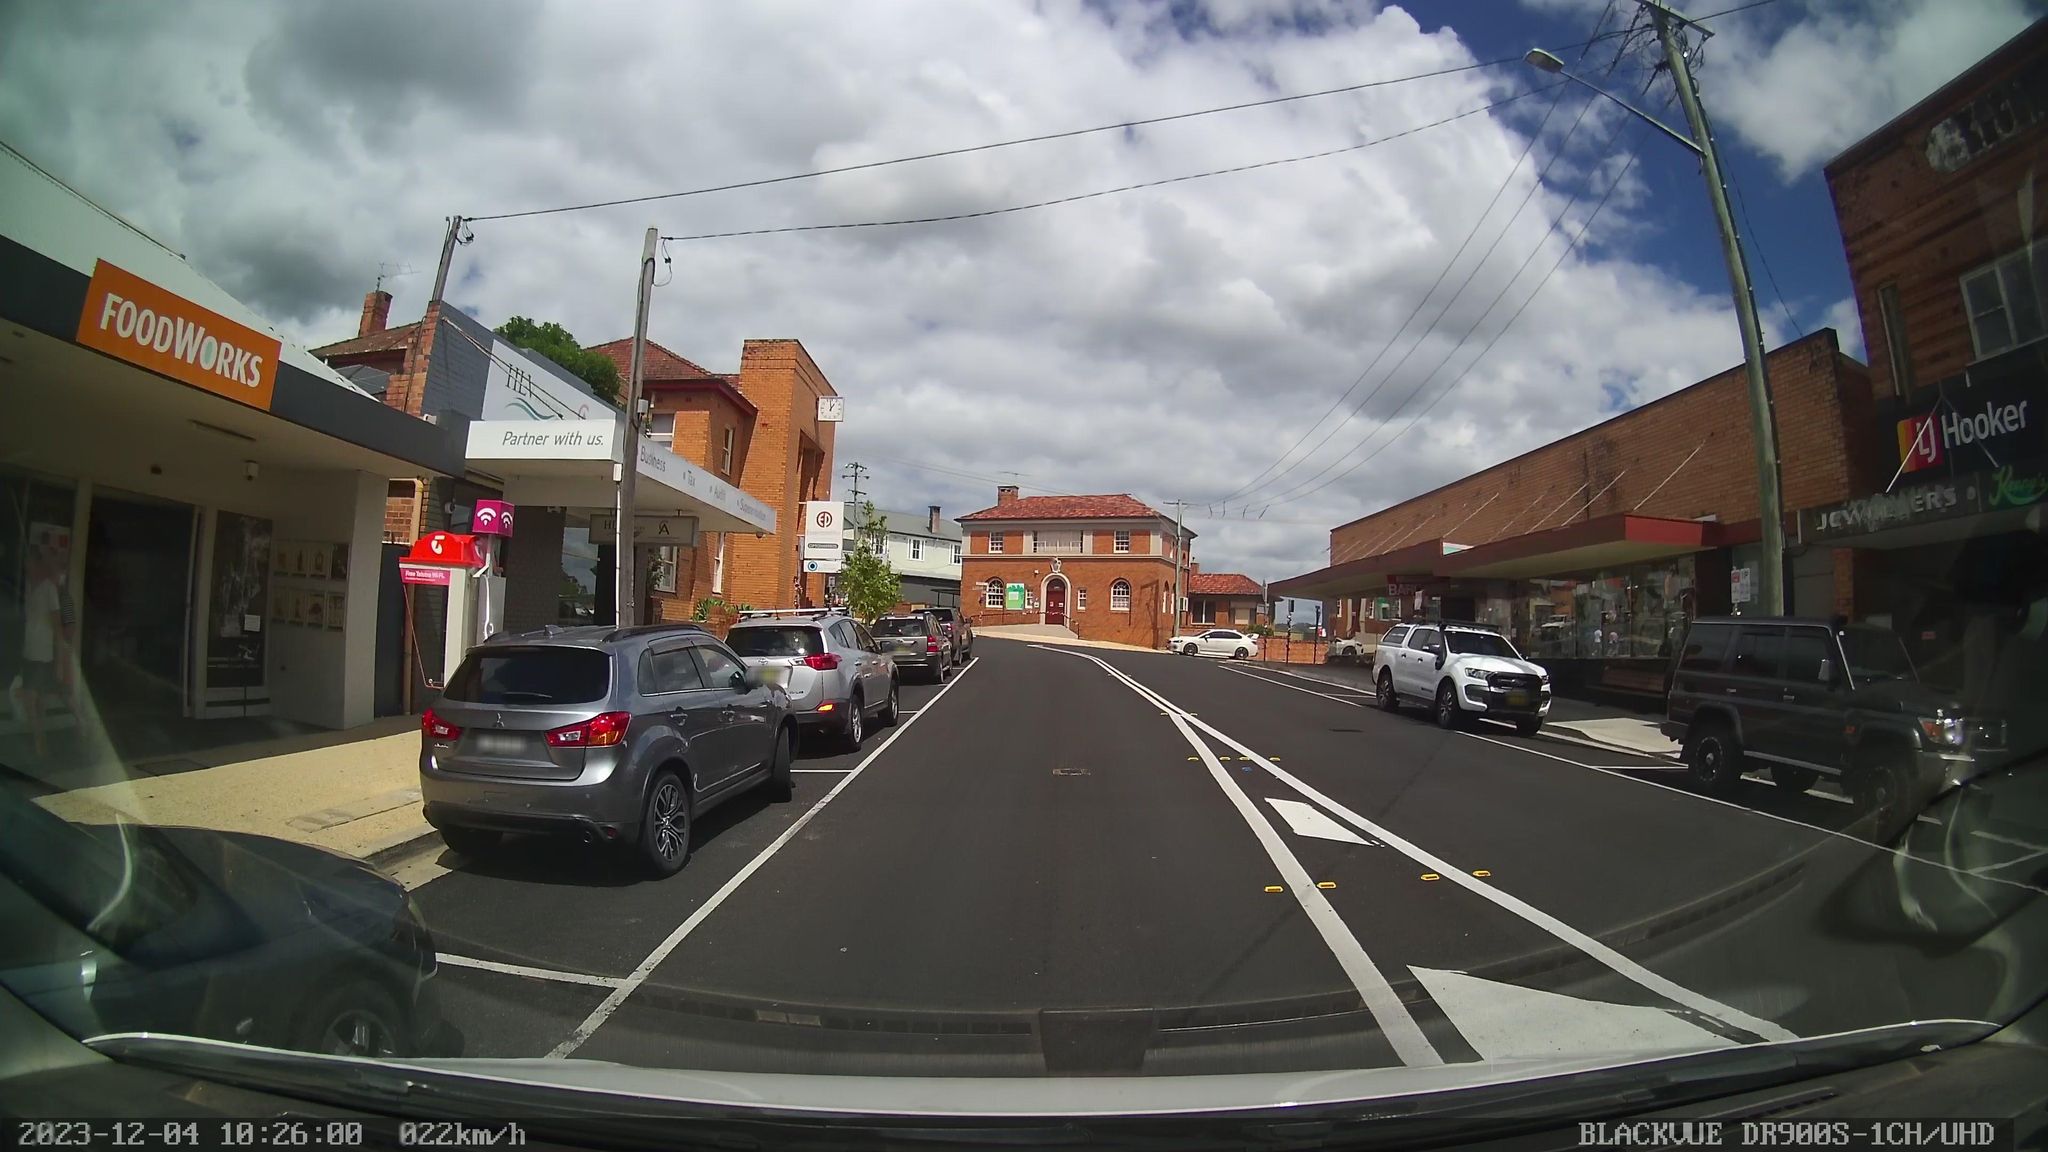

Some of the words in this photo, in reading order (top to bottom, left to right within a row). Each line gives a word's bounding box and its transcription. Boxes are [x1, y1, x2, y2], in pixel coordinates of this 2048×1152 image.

[100, 292, 264, 388] FOODWORKS
[502, 431, 550, 446] Partner
[554, 430, 583, 446] with
[586, 434, 604, 446] us.
[1916, 416, 1937, 463] LJ
[1941, 400, 2028, 449] Hooker
[640, 445, 667, 473] Business
